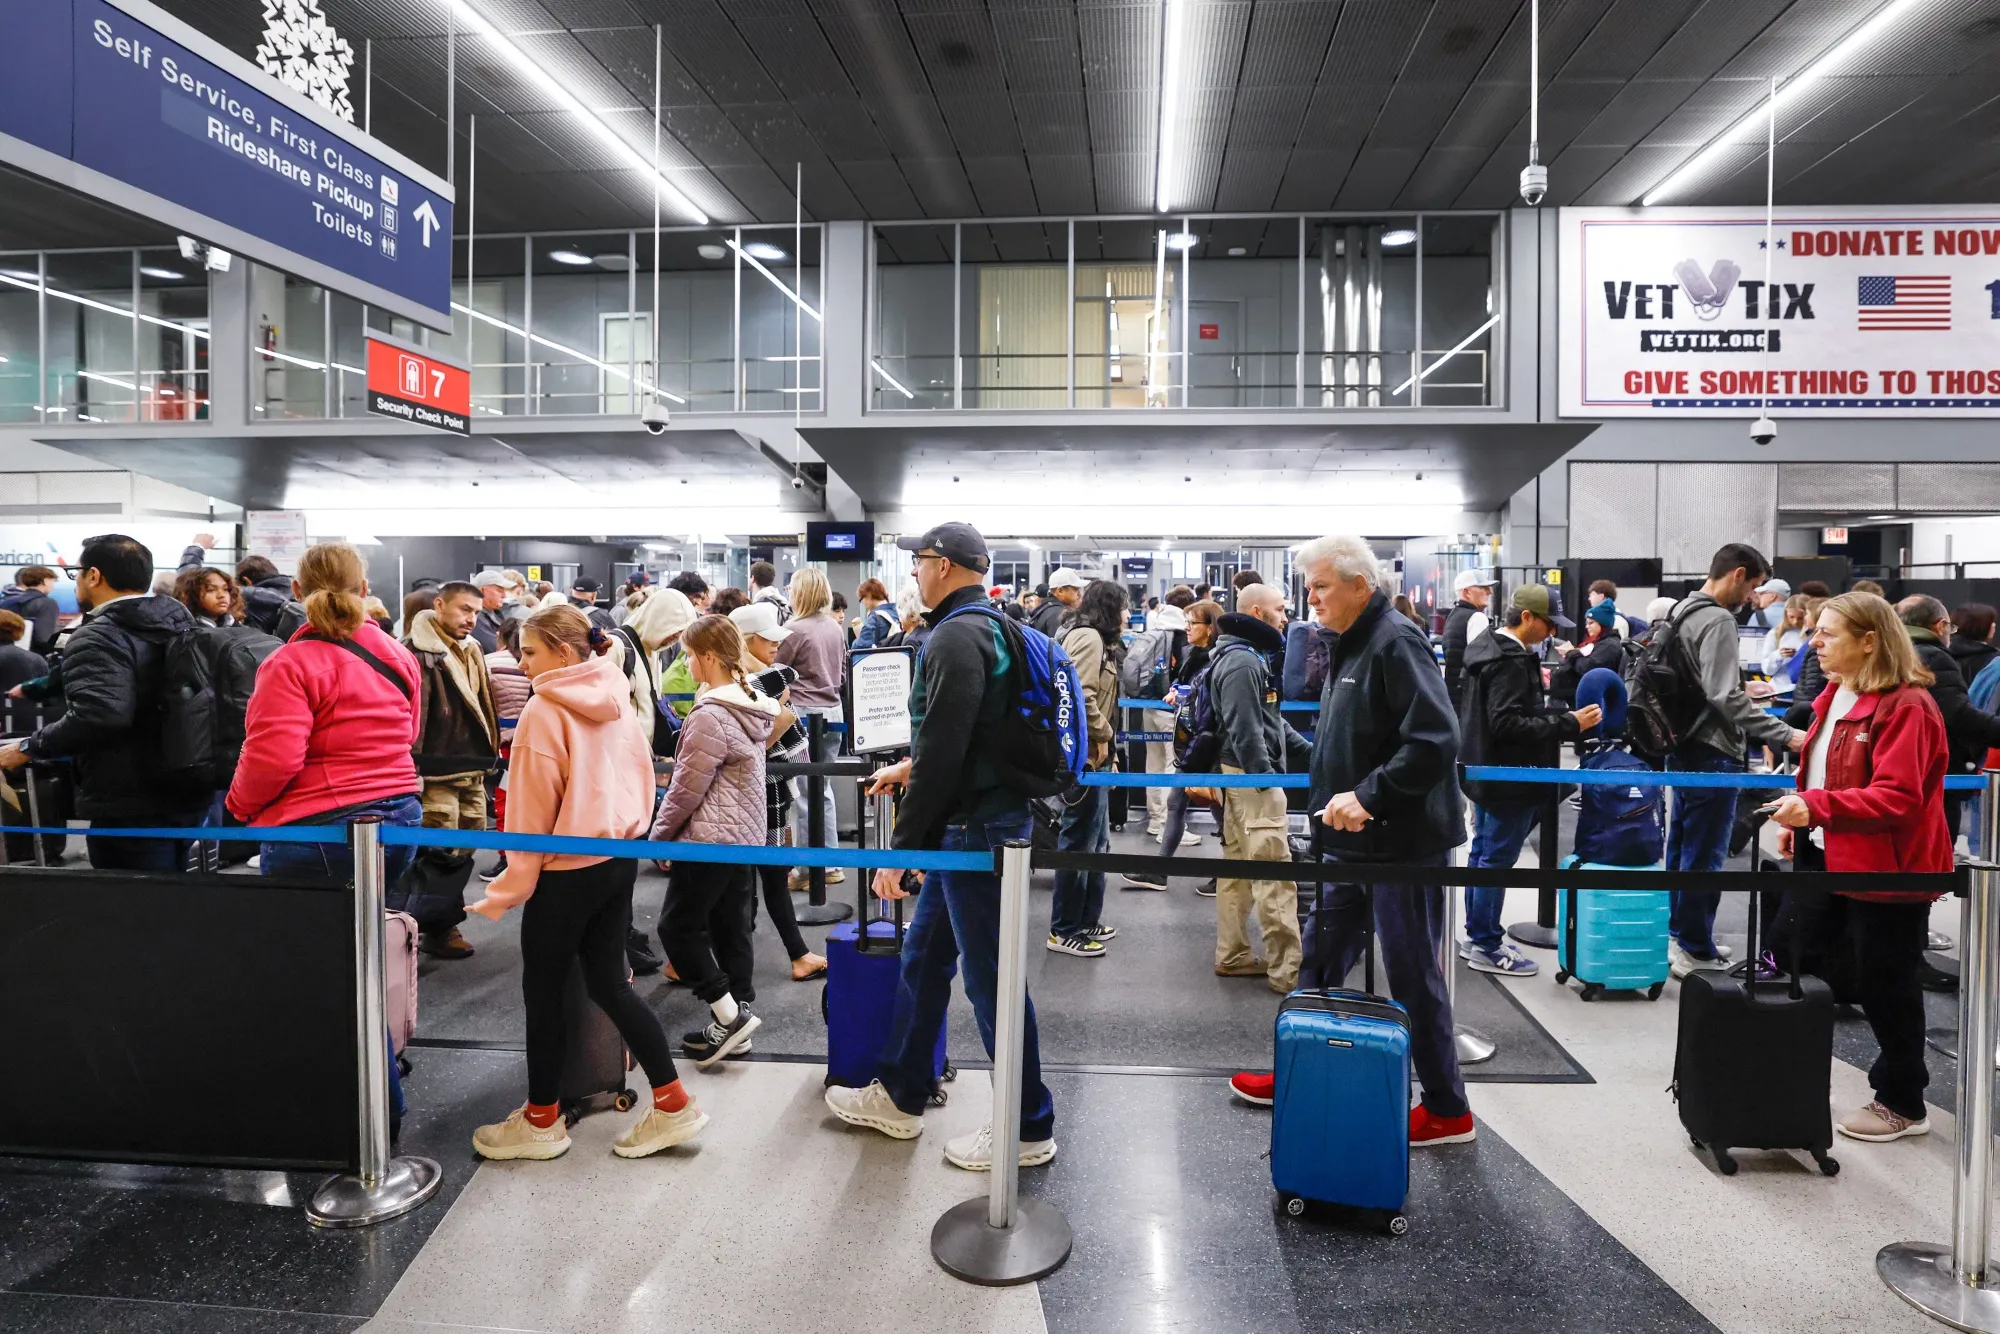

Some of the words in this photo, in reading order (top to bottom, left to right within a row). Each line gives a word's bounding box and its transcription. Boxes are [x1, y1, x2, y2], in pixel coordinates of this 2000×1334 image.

[93, 19, 152, 69] Self
[161, 57, 262, 134] Service,
[270, 116, 318, 159] First
[323, 147, 374, 189] Class
[207, 115, 311, 186] Rideshare
[317, 173, 374, 220] Pickup
[312, 201, 373, 246] Toilets
[1791, 230, 1924, 257] DONATE
[1603, 281, 1679, 319] VET
[1738, 280, 1815, 319] TIX
[1650, 333, 1767, 347] VETTIX.ORG
[430, 369, 446, 398] 7
[1624, 370, 1689, 394] GIVE
[1700, 370, 1869, 395] SOMETHING
[1879, 370, 1917, 395] TO
[1926, 370, 2000, 395] THOS
[376, 397, 414, 420] Security
[415, 407, 442, 424] Check
[443, 415, 464, 430] Point
[530, 567, 538, 580] 5
[1551, 570, 1558, 583] 1
[1055, 671, 1072, 728] adidas
